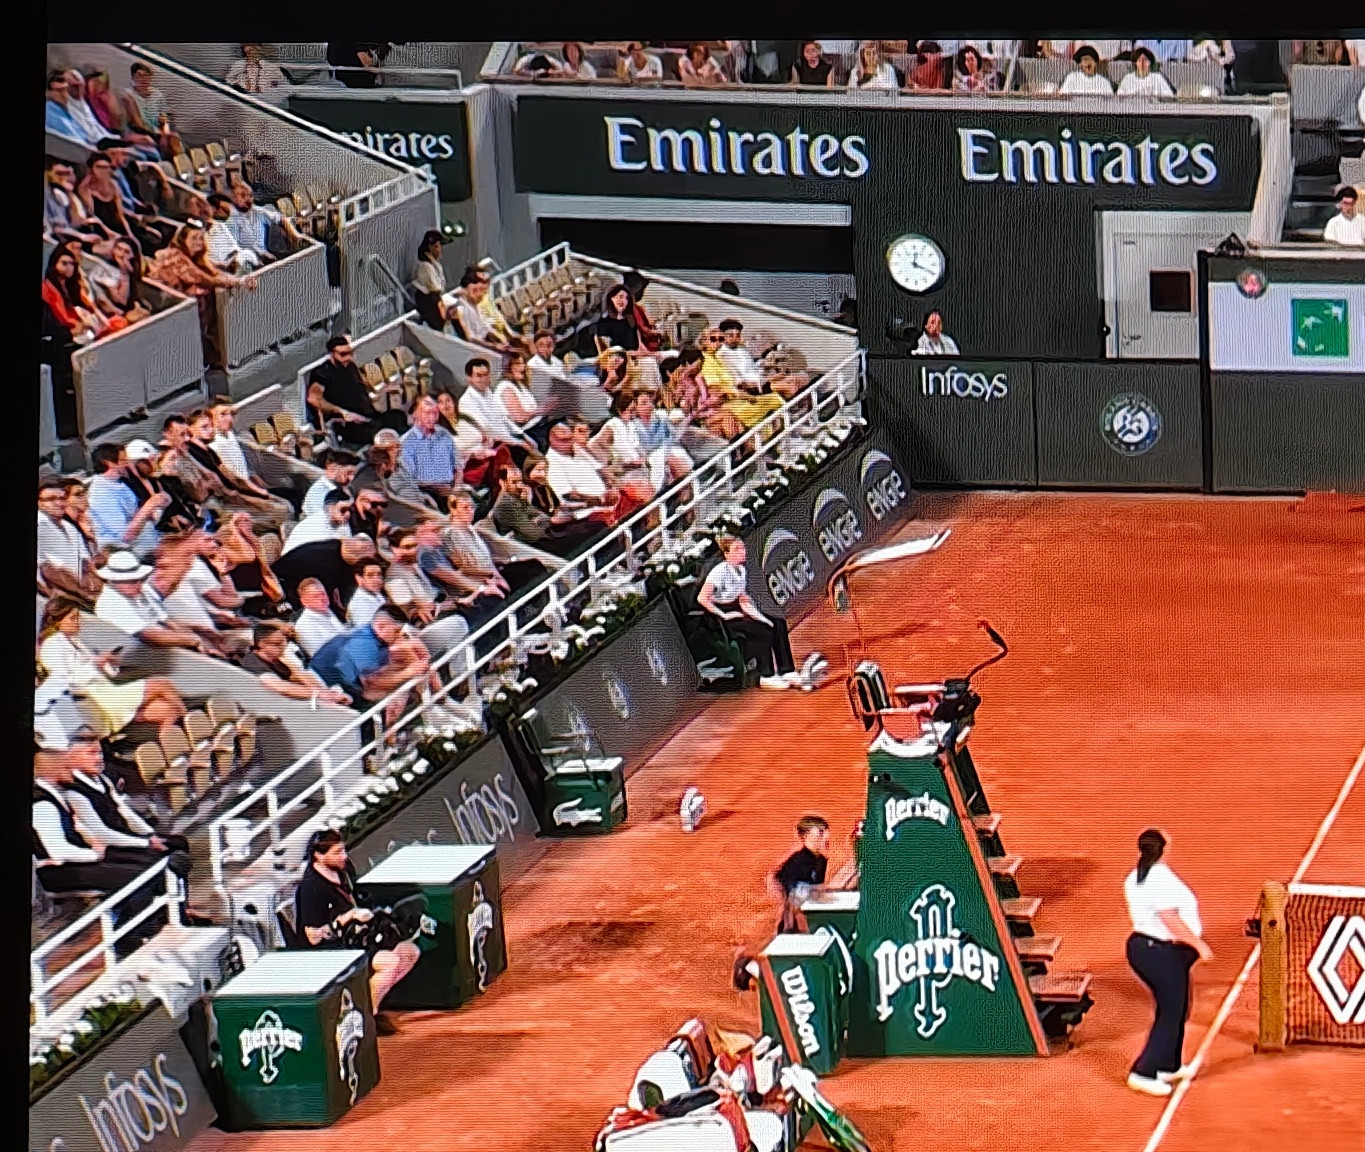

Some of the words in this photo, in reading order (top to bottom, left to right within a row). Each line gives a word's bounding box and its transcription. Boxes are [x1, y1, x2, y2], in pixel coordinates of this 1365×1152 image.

[604, 115, 869, 178] Emirates
[956, 127, 1218, 187] Emirates
[921, 365, 1008, 402] Infosys
[780, 967, 820, 1058] Wilson
